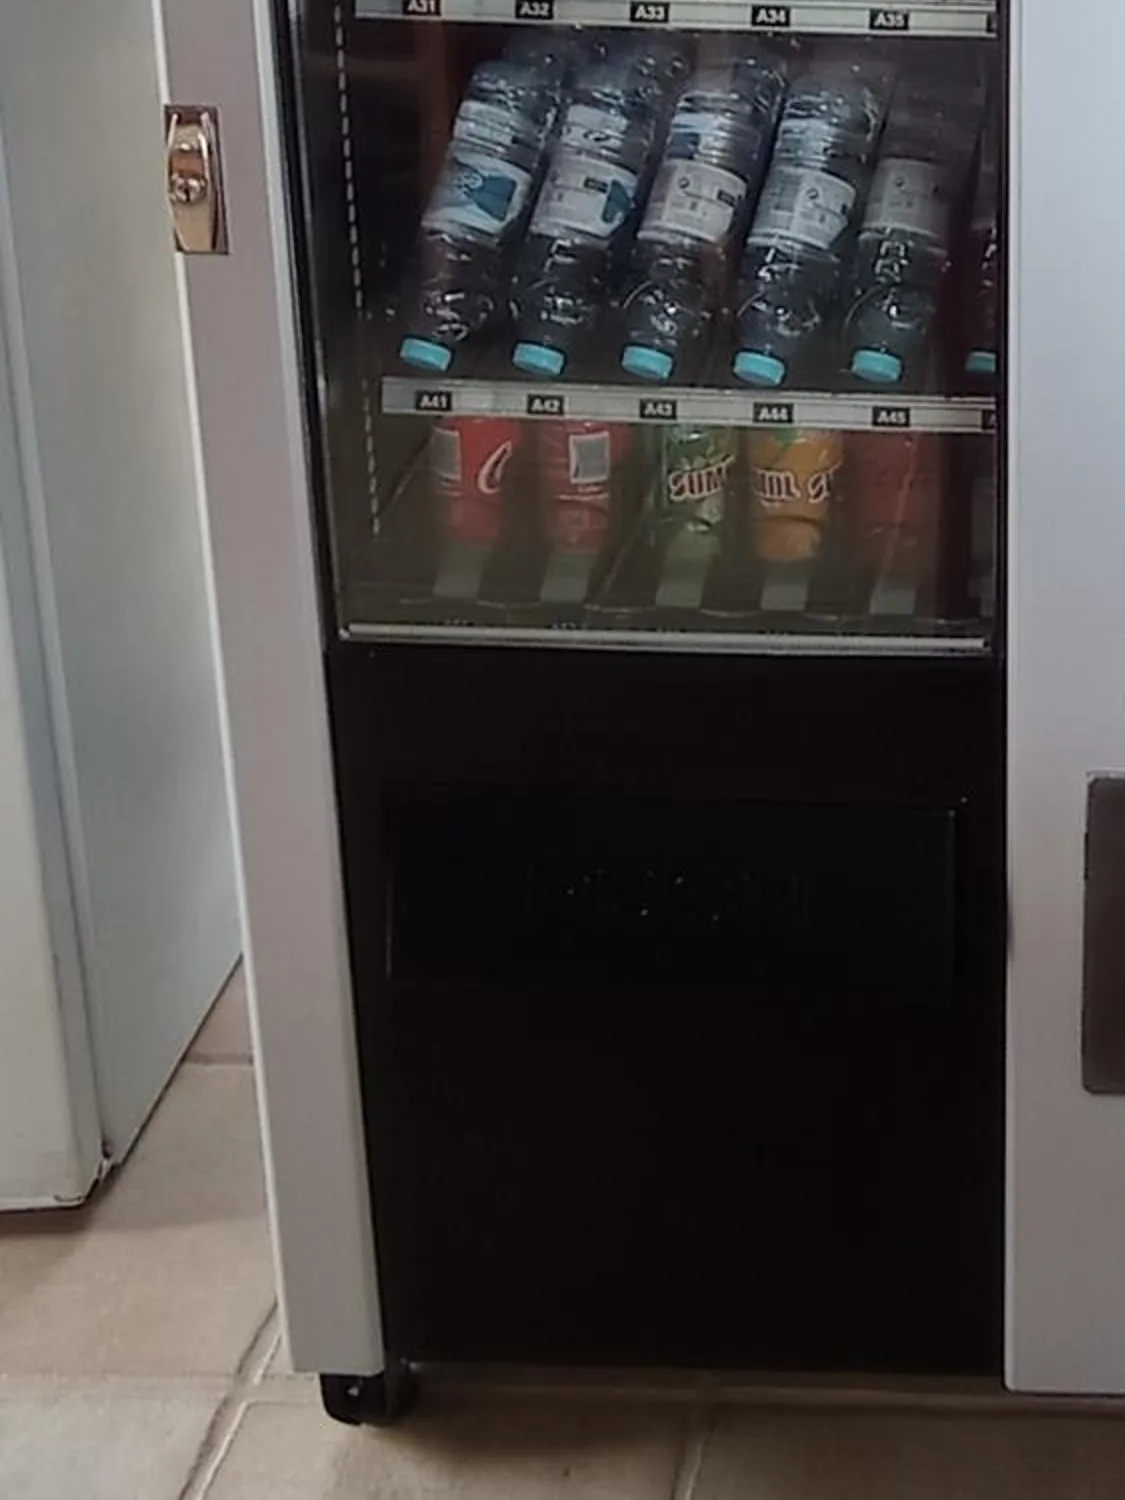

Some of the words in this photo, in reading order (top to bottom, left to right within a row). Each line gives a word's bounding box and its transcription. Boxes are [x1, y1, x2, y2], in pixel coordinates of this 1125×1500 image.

[407, 0, 436, 13] A31
[518, 2, 550, 17] A32
[634, 4, 665, 20] A33
[755, 7, 787, 24] A34
[873, 12, 904, 28] A35
[419, 393, 448, 409] A41
[530, 397, 561, 412] A42
[644, 402, 673, 417] A43
[758, 406, 789, 421] A44
[876, 410, 906, 425] A45
